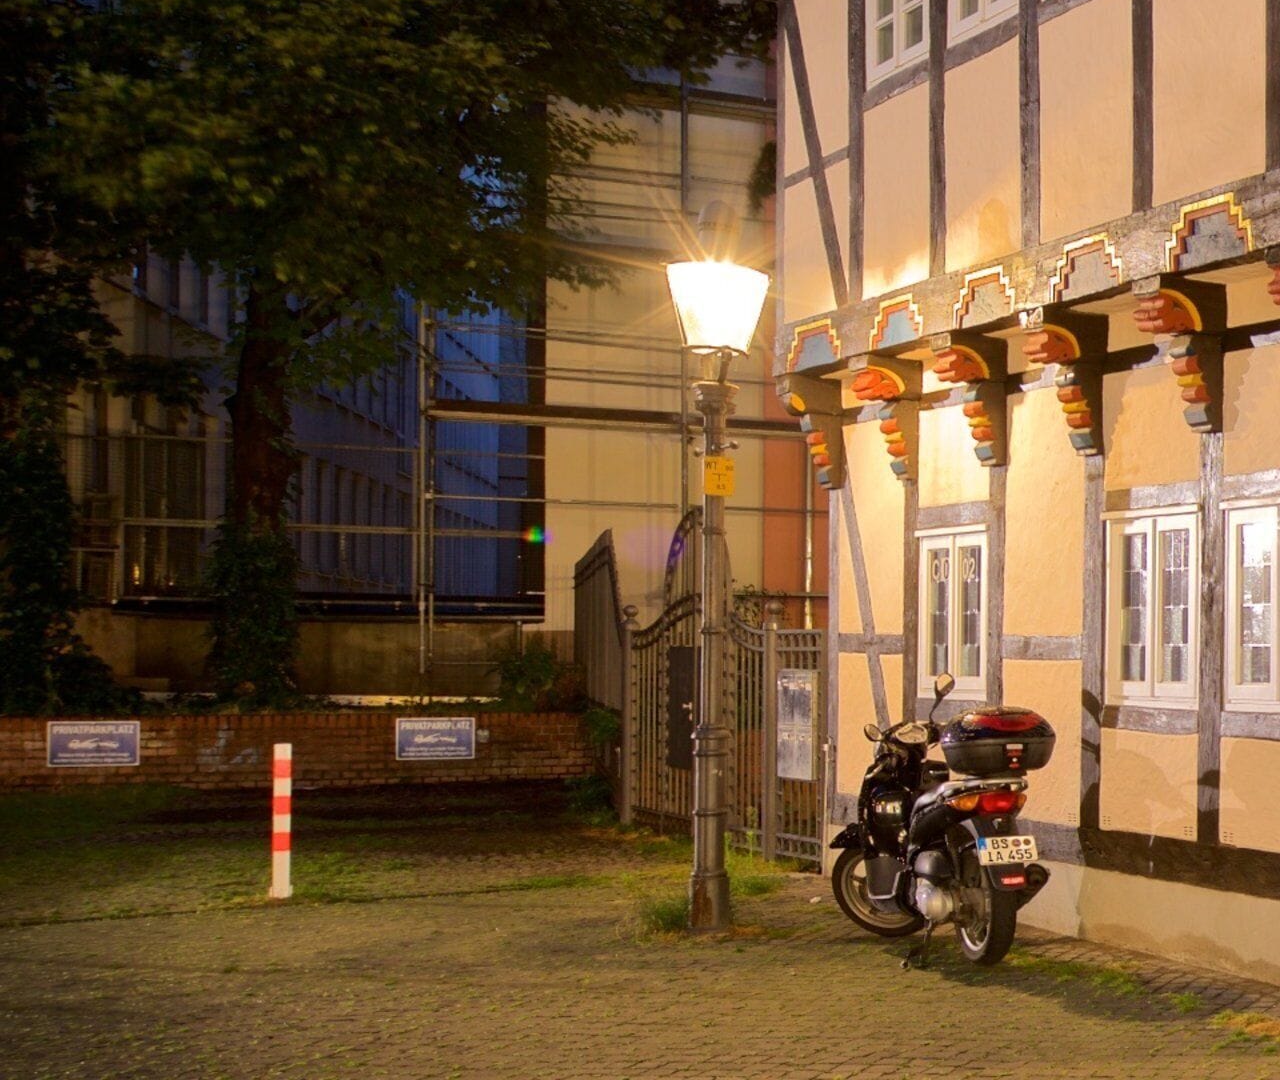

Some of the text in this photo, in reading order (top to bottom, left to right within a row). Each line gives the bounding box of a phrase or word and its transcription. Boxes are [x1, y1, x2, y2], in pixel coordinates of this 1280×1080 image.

[962, 557, 976, 581] 02
[52, 724, 135, 735] PRIVATPARKPLATZ
[400, 721, 470, 731] PRIVATPARKPLATZ
[991, 838, 1009, 850] BS
[1008, 848, 1033, 861] 455
